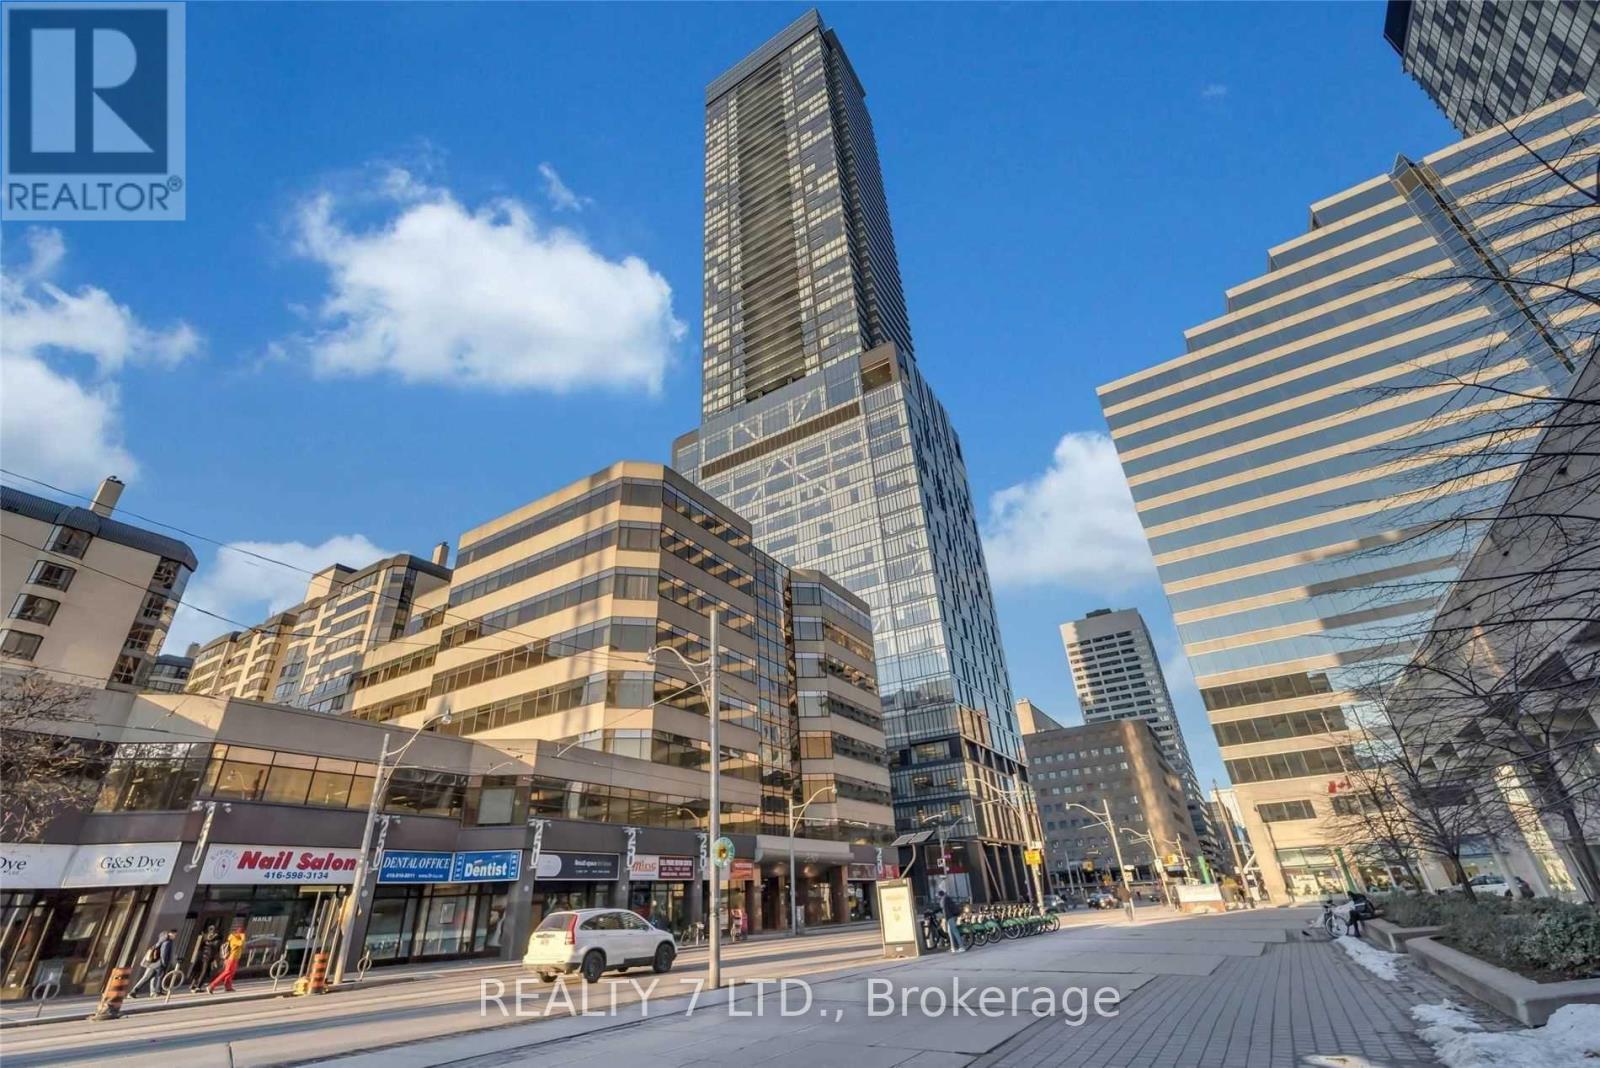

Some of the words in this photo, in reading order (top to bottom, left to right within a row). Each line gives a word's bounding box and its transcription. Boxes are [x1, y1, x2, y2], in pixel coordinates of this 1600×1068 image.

[373, 818, 390, 868] 250
[531, 822, 544, 866] 250
[626, 829, 637, 868] 250
[699, 835, 708, 868] 250
[100, 856, 134, 869] G&S
[138, 855, 166, 870] Dye
[237, 851, 294, 870] Nail
[296, 852, 357, 871] Salon
[383, 857, 418, 869] DENTAL
[419, 858, 451, 869] OFFICE
[464, 862, 508, 877] Dentist
[264, 871, 329, 880] 416-598-3134
